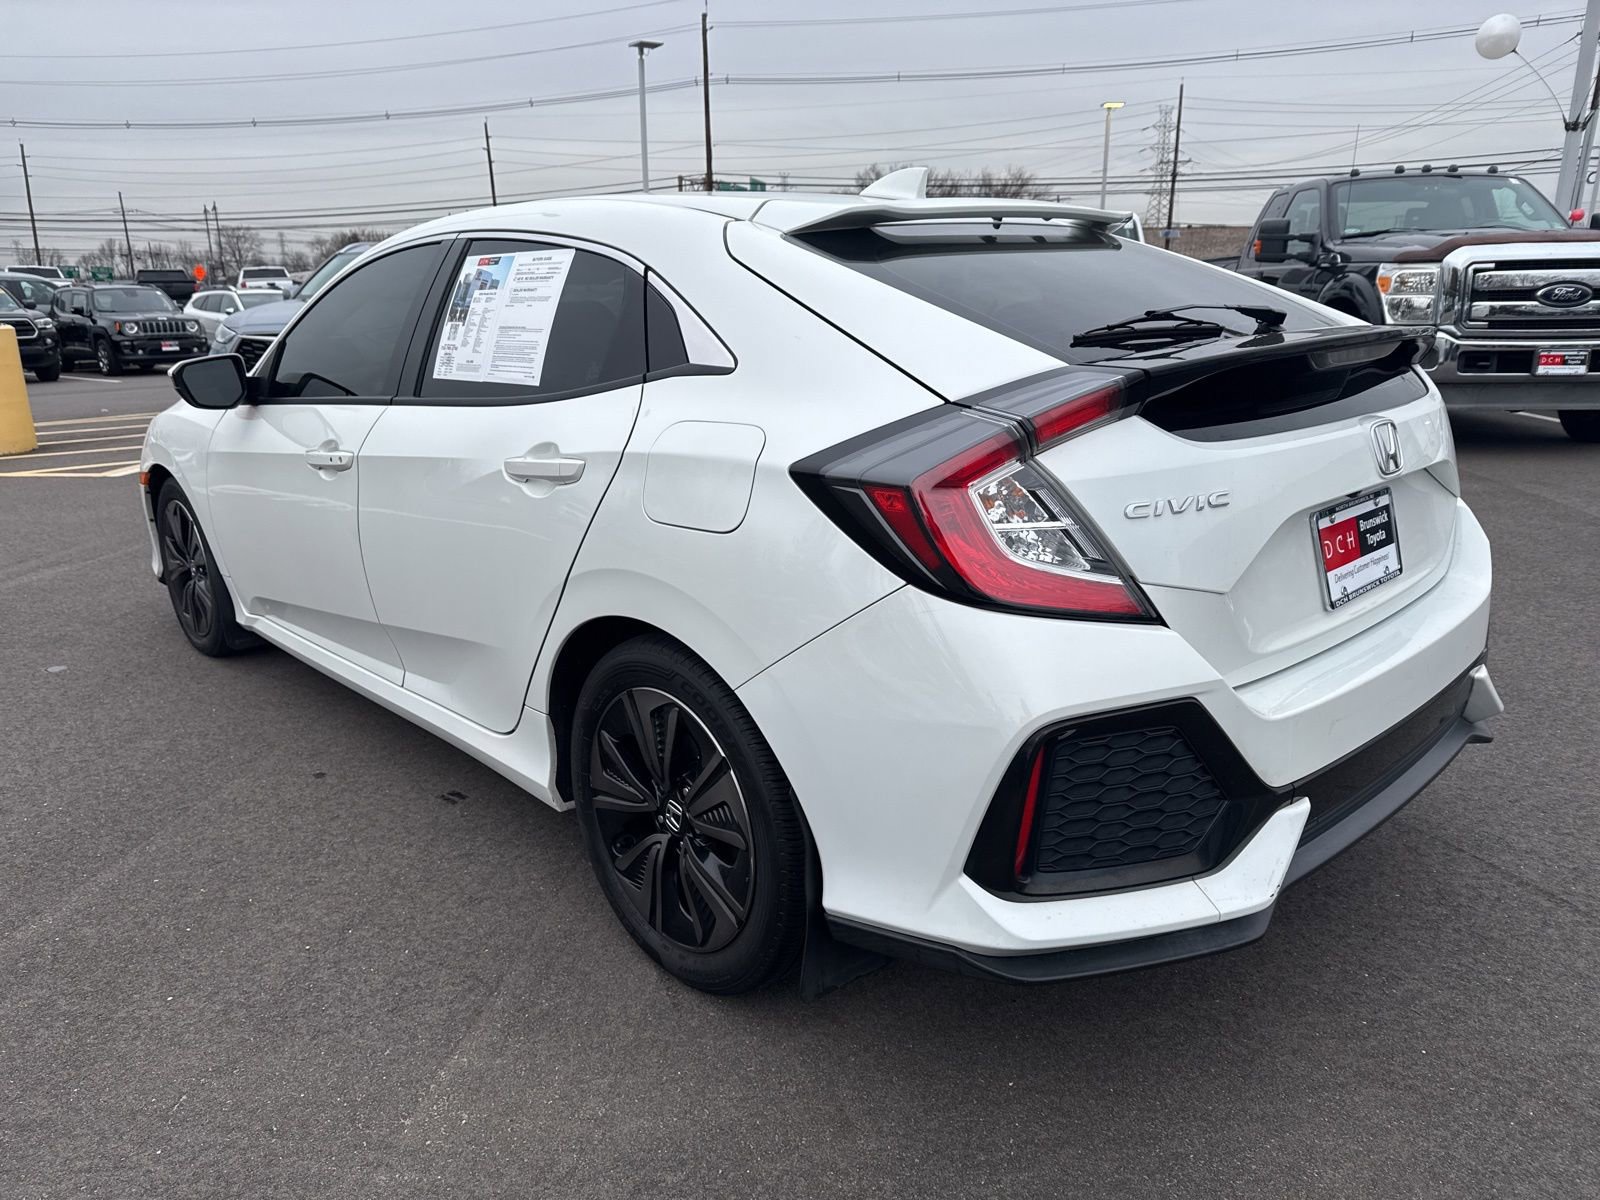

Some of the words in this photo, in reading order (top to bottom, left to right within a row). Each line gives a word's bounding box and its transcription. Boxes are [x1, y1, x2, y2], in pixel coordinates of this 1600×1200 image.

[1552, 287, 1582, 300] Ford
[1123, 490, 1231, 520] CIVIC
[1359, 510, 1389, 531] Brunswick
[1323, 530, 1355, 559] DCH
[1366, 529, 1386, 546] Toyota
[1335, 596, 1349, 607] DCH
[1348, 580, 1380, 599] BRUNSWICK
[1380, 569, 1401, 583] TOYOTA
